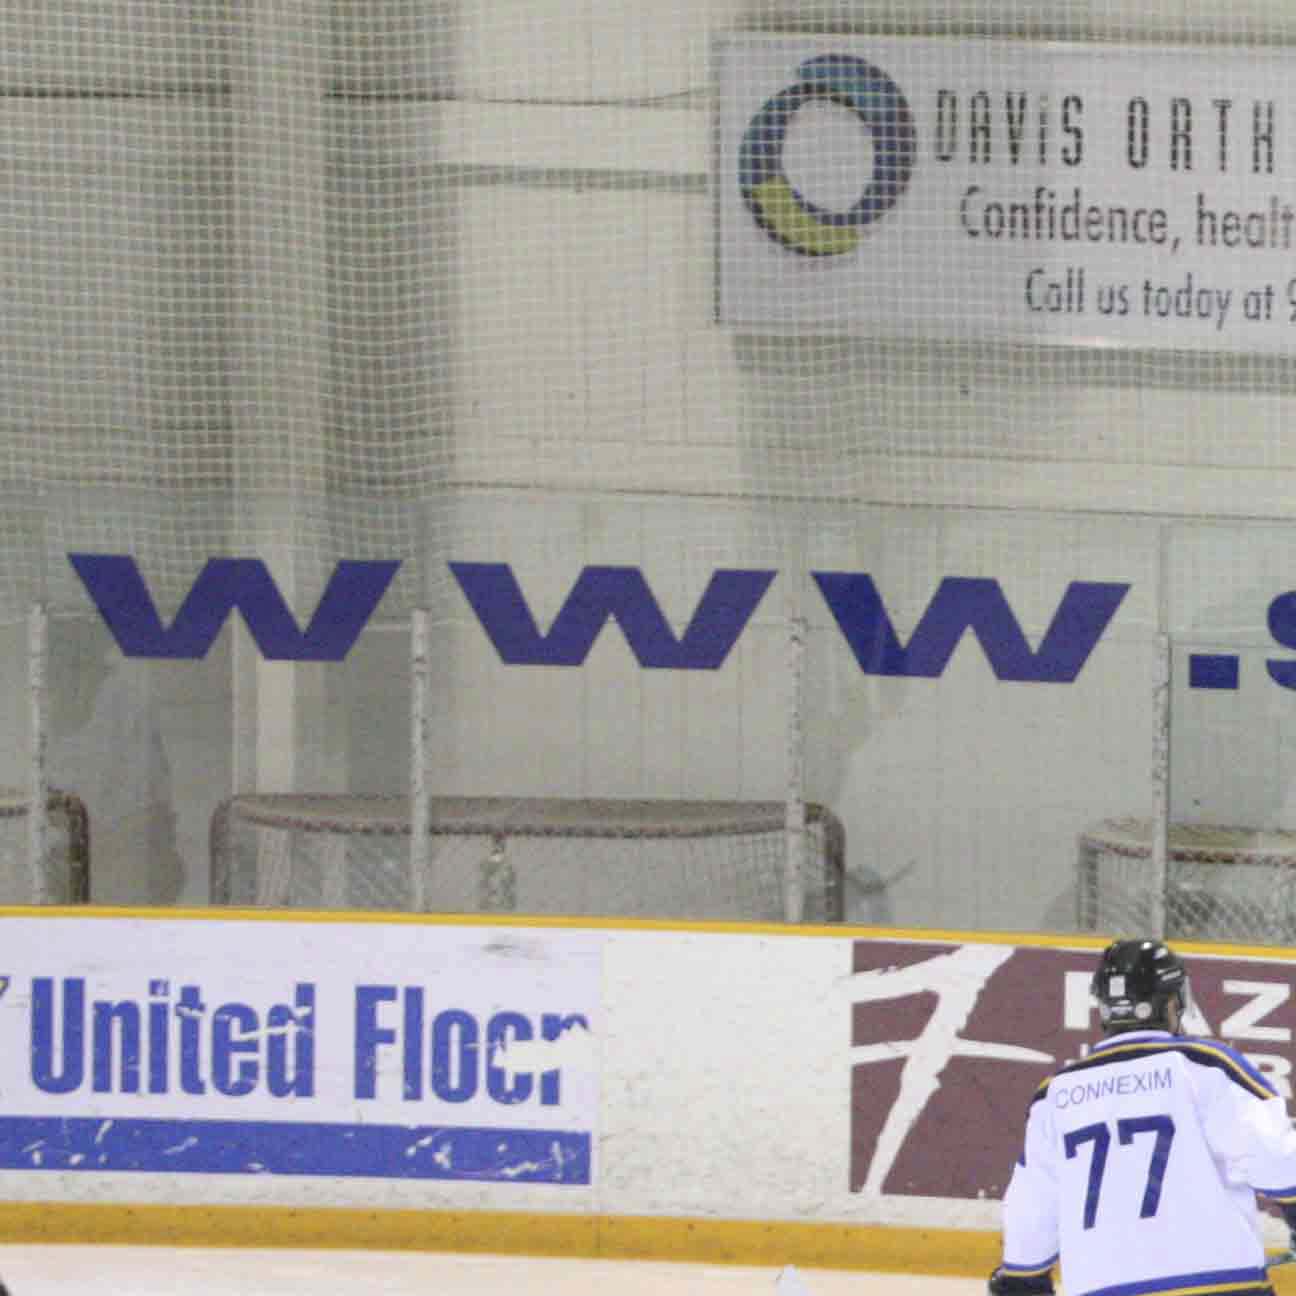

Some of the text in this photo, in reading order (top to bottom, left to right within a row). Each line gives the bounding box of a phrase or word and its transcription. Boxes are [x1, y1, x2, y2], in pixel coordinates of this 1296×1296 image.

[960, 185, 1180, 255] Confidence,
[1026, 267, 1084, 313] Call
[1098, 283, 1130, 316] us
[1144, 272, 1232, 331] today
[1244, 283, 1275, 320] at
[31, 977, 315, 1099] United
[1054, 1067, 1173, 1109] CONNEXIM
[1063, 1113, 1177, 1231] 77
